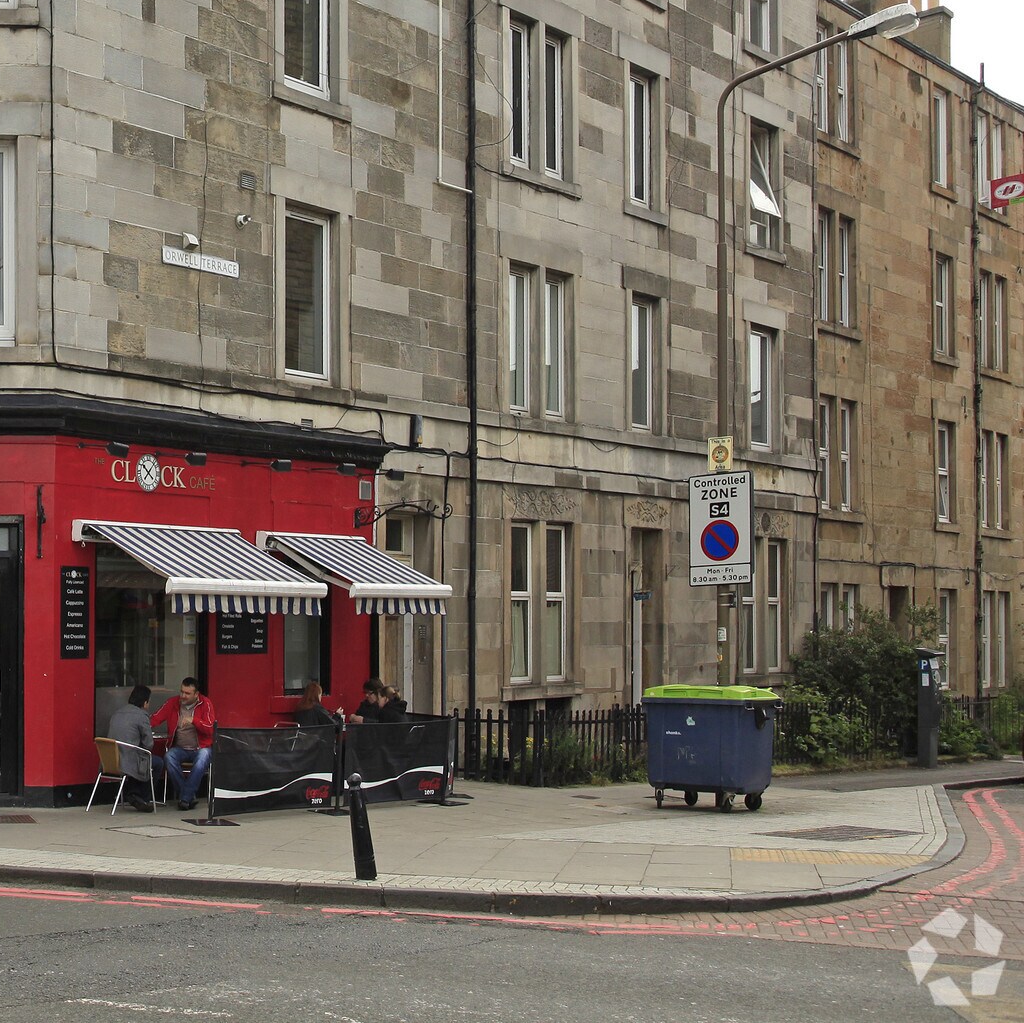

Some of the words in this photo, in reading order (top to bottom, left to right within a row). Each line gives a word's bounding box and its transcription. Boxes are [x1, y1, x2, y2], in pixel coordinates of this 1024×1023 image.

[165, 250, 198, 267] ORWELL
[201, 257, 237, 275] TERRACE
[94, 457, 105, 465] THE
[189, 475, 216, 491] CAFÉ
[693, 475, 746, 488] Controlled
[701, 487, 738, 500] ZONE
[711, 504, 728, 516] S4
[921, 659, 928, 670] P
